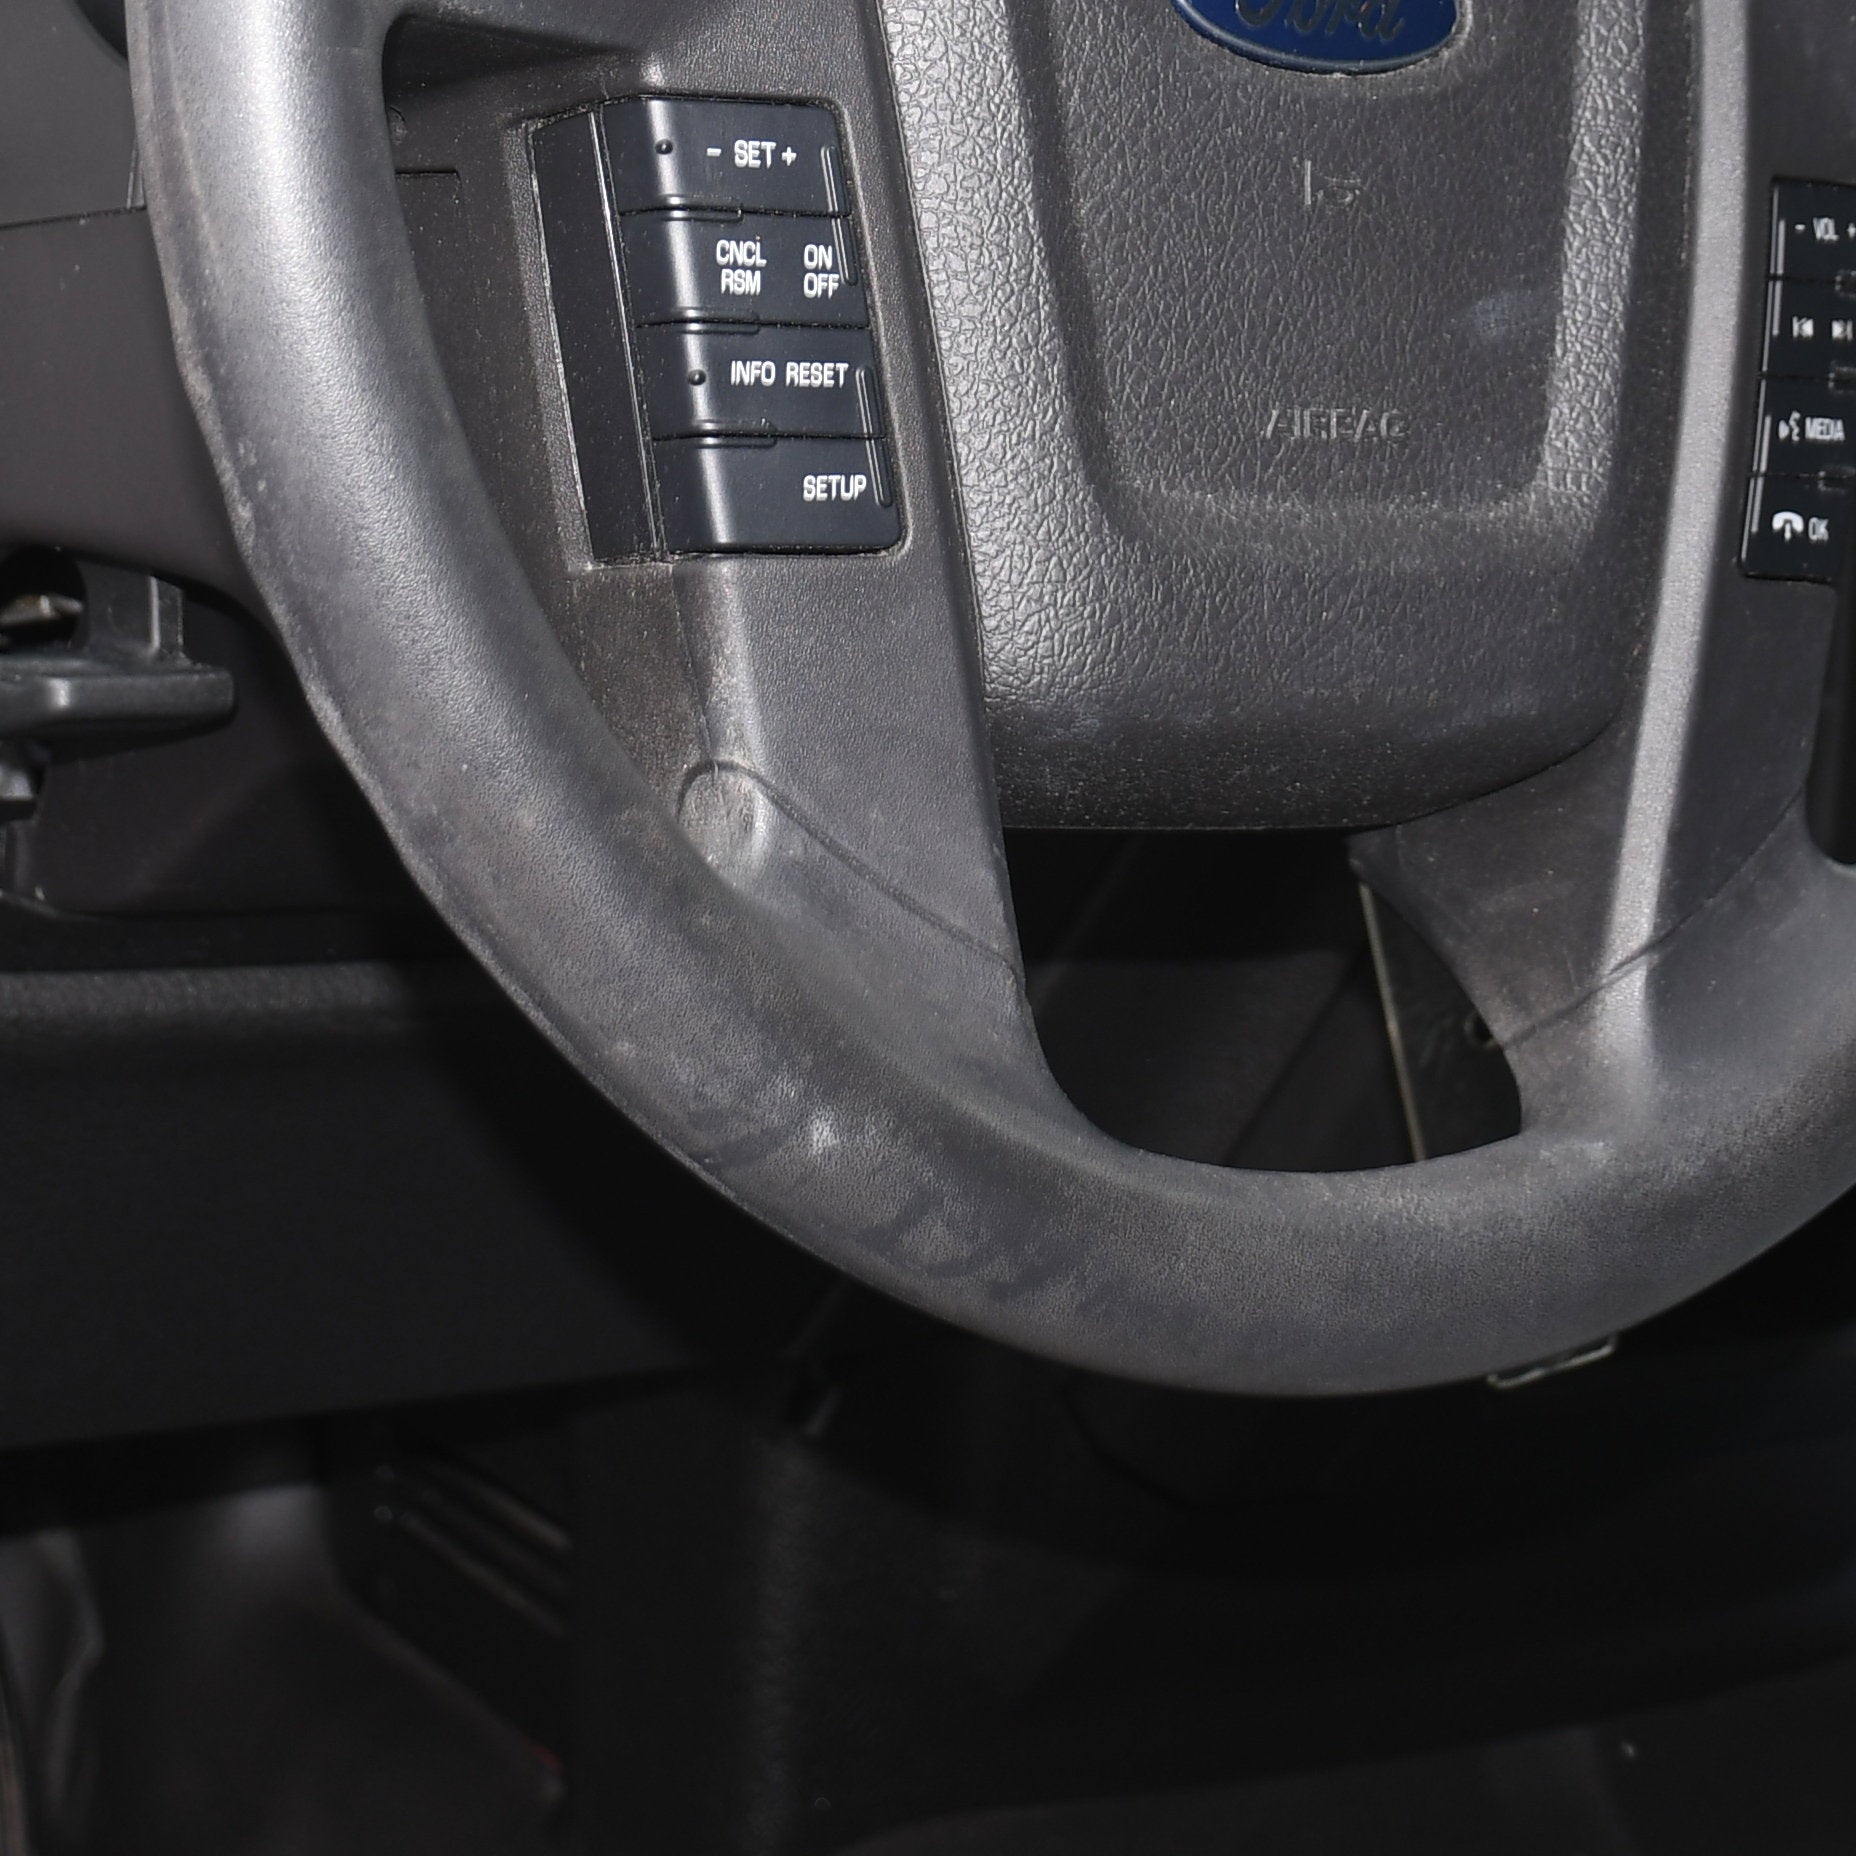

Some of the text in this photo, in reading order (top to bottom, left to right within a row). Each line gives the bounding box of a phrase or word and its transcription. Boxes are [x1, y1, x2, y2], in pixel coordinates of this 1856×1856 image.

[734, 141, 776, 169] SET
[1813, 217, 1839, 241] VOL
[716, 240, 767, 267] CNCL
[803, 245, 833, 270] ON
[721, 269, 761, 295] RSM
[803, 273, 840, 298] OFF
[731, 361, 849, 387] INFO RESET
[1805, 416, 1845, 442] MEDIA
[803, 475, 867, 501] SETUP
[1809, 516, 1829, 542] OK
